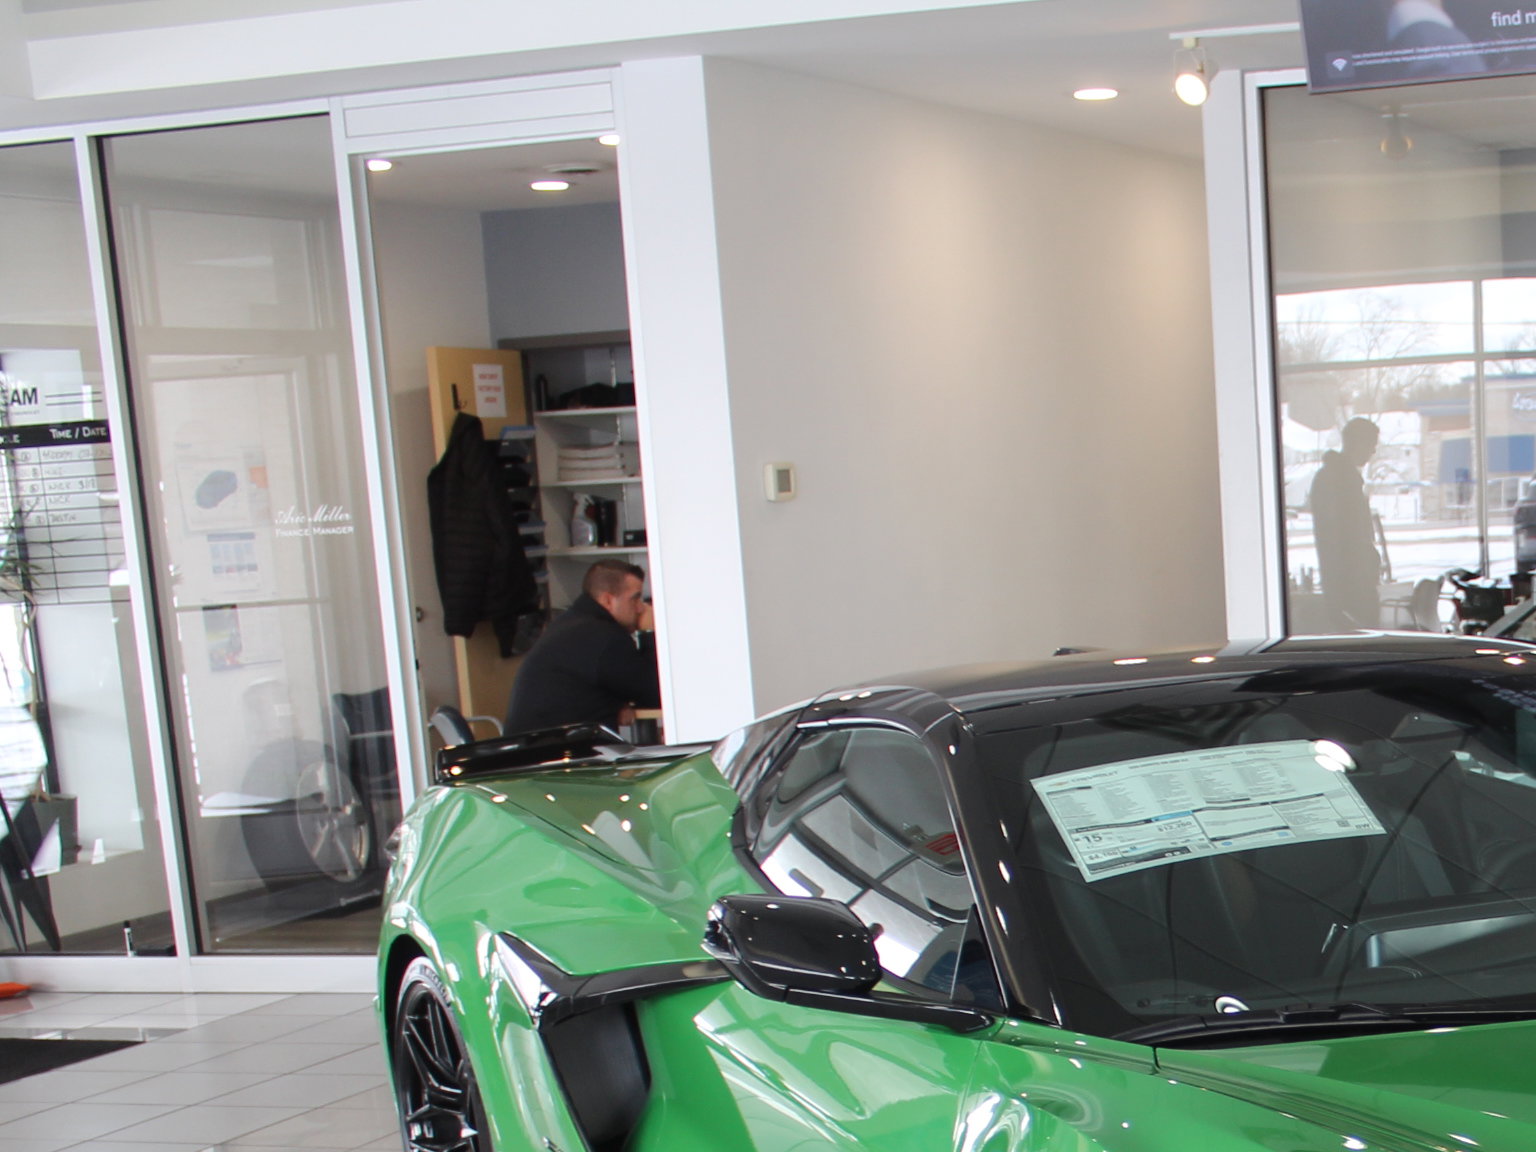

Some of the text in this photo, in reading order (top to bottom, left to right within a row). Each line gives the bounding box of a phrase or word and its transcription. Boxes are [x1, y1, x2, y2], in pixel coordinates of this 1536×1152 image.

[1491, 9, 1522, 27] find
[49, 428, 73, 440] TIME
[82, 425, 107, 438] DATE
